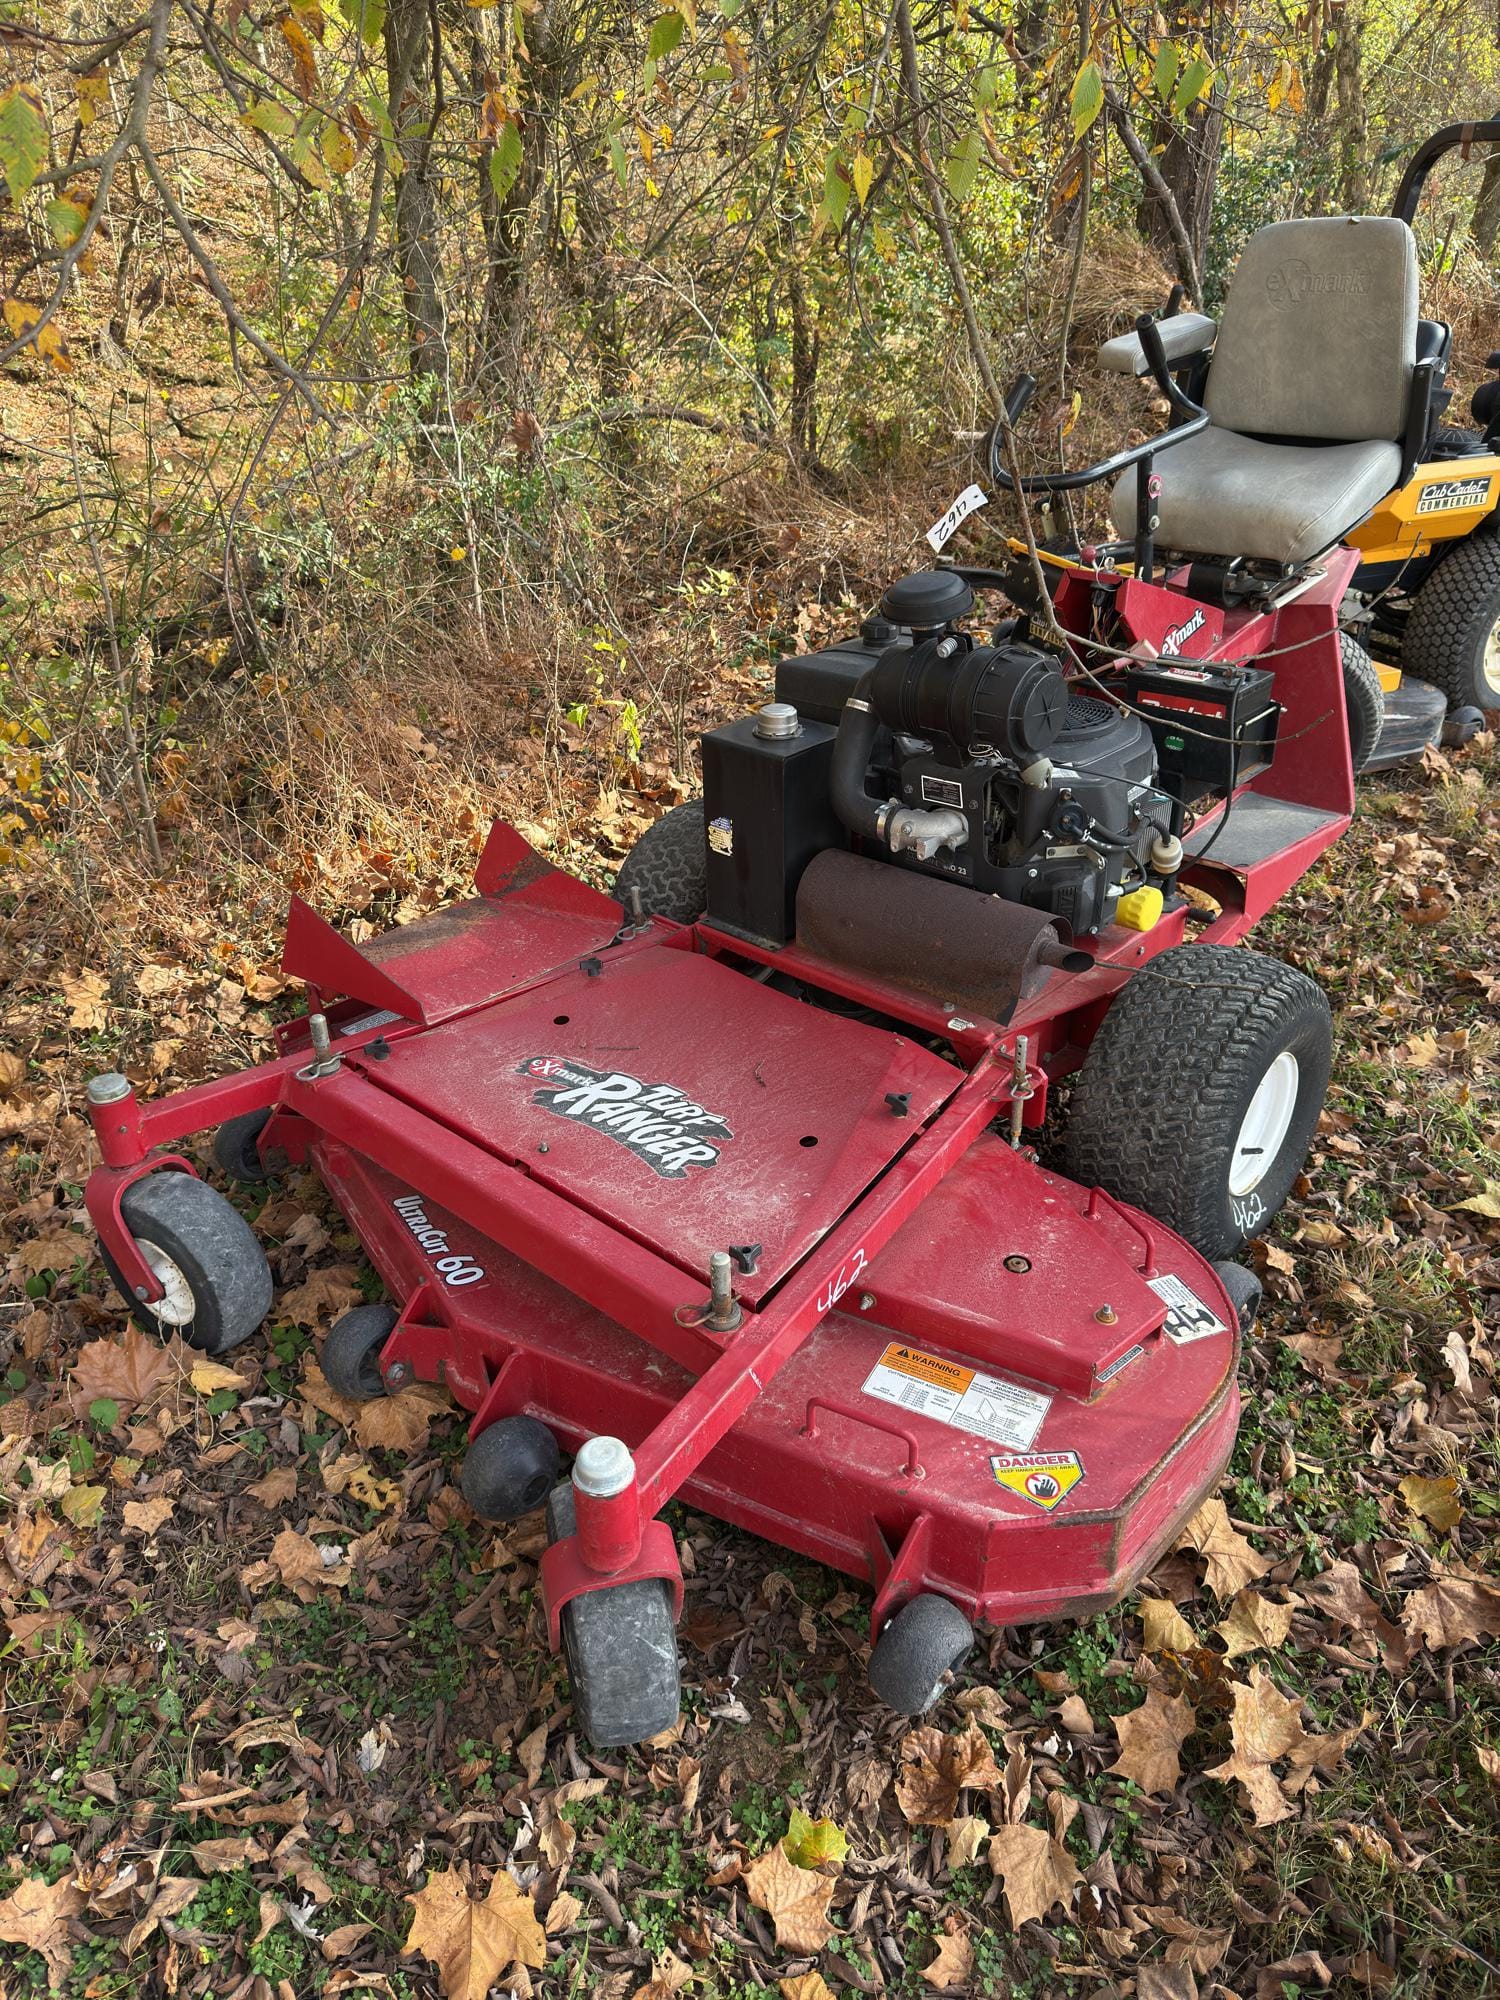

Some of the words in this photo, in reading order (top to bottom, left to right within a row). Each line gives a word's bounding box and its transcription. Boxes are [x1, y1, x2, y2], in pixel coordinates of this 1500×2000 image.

[1420, 493, 1485, 512] COMMERCIAL
[1421, 484, 1448, 500] Cub
[1446, 479, 1489, 496] Cadet
[934, 500, 968, 542] 462
[957, 866, 967, 876] 23
[551, 1073, 718, 1171] RANGER
[1232, 1192, 1268, 1234] 462
[435, 1255, 485, 1286] 60
[816, 1248, 869, 1312] 462
[911, 1353, 962, 1377] WARNING
[998, 1454, 1071, 1468] DANGER
